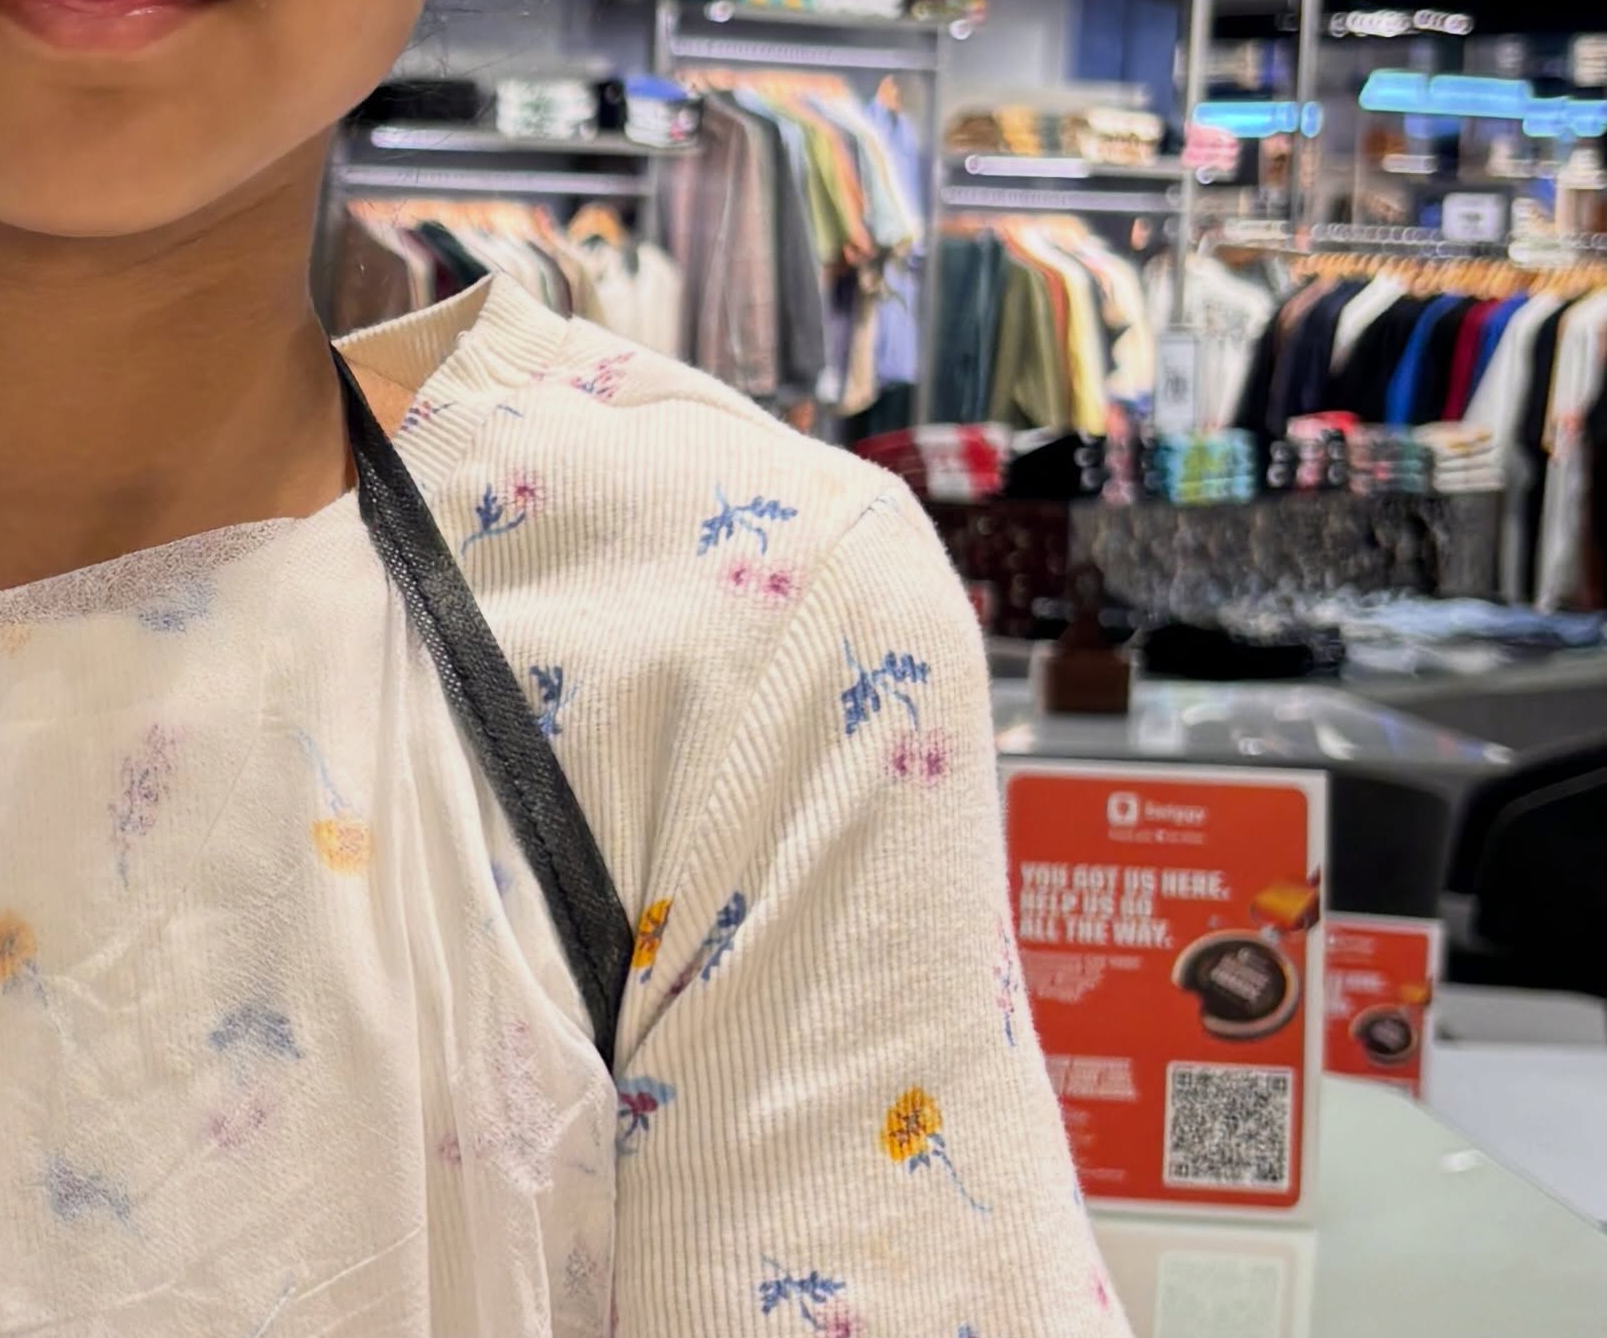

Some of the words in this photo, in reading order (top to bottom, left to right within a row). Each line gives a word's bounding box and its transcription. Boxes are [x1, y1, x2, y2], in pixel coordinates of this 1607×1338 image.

[1020, 862, 1068, 888] YOU
[1072, 863, 1119, 891] GOT
[1122, 866, 1156, 894] US
[1160, 867, 1231, 901] HERE.
[1019, 888, 1079, 916] HELP
[1082, 890, 1115, 918] US
[1119, 893, 1153, 918] GO
[1018, 917, 1060, 944] ALL
[1065, 917, 1109, 947] THE
[1112, 918, 1175, 950] WAY.
